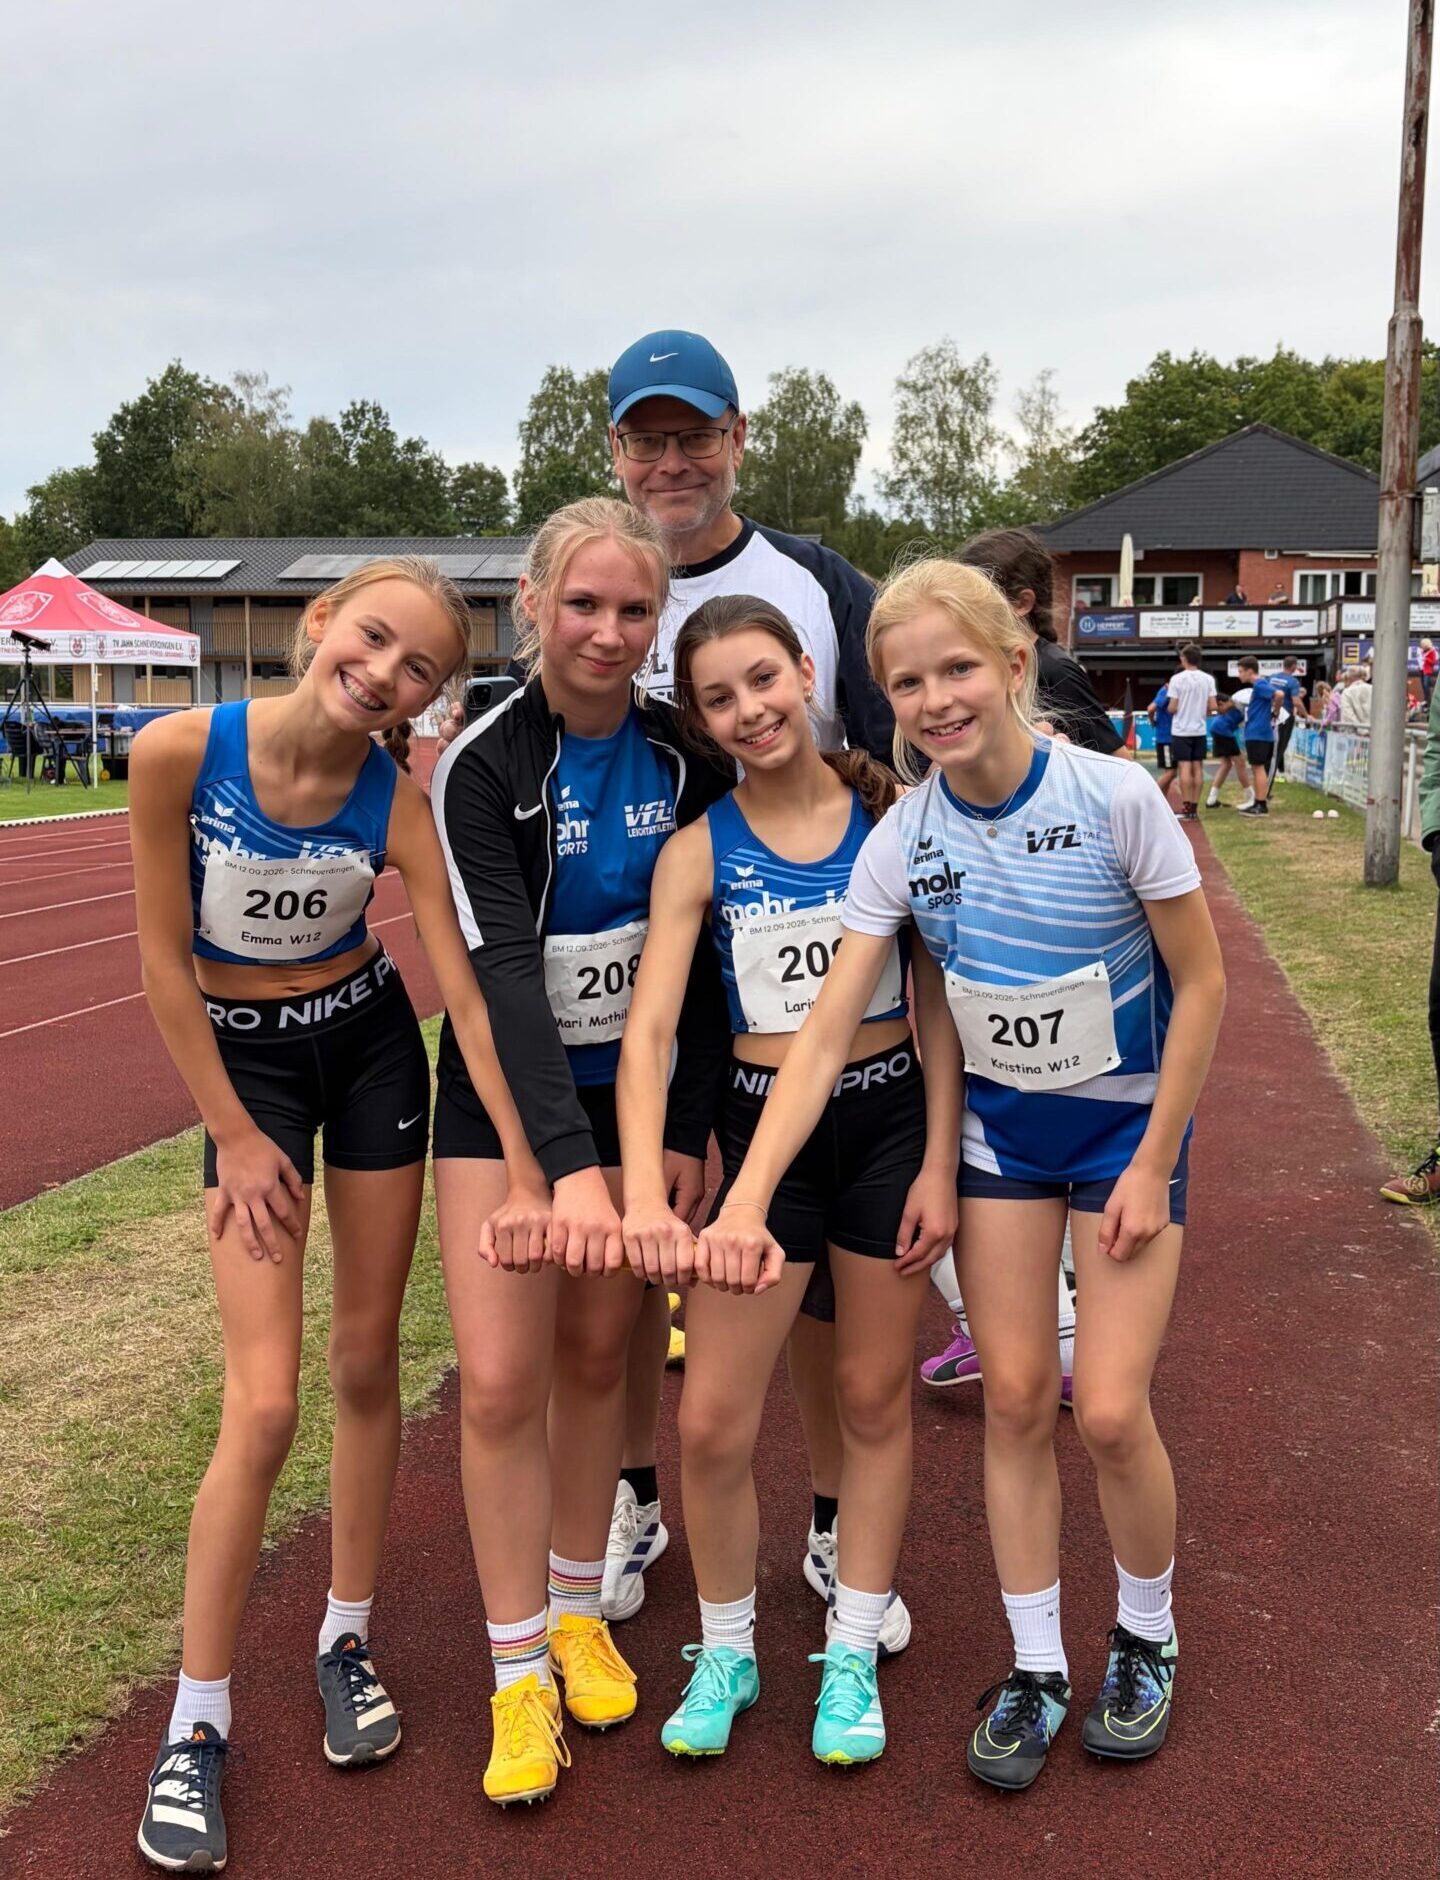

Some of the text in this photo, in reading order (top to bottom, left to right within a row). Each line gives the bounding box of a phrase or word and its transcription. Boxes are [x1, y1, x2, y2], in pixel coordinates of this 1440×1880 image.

[121, 640, 133, 648] JAHN
[134, 640, 174, 650] SCHNEVERDINGEN
[201, 814, 236, 835] erima
[557, 840, 588, 856] ORTS
[913, 847, 944, 867] erima
[224, 860, 237, 870] BM
[730, 879, 764, 891] erima
[243, 889, 328, 921] 206
[241, 931, 321, 946] Emma W12
[749, 926, 762, 935] BM
[552, 945, 564, 953] BM
[278, 970, 373, 1029] NIKE
[987, 1009, 1065, 1049] 207
[832, 1051, 911, 1097] PRO
[990, 1055, 1081, 1075] Kristina W12
